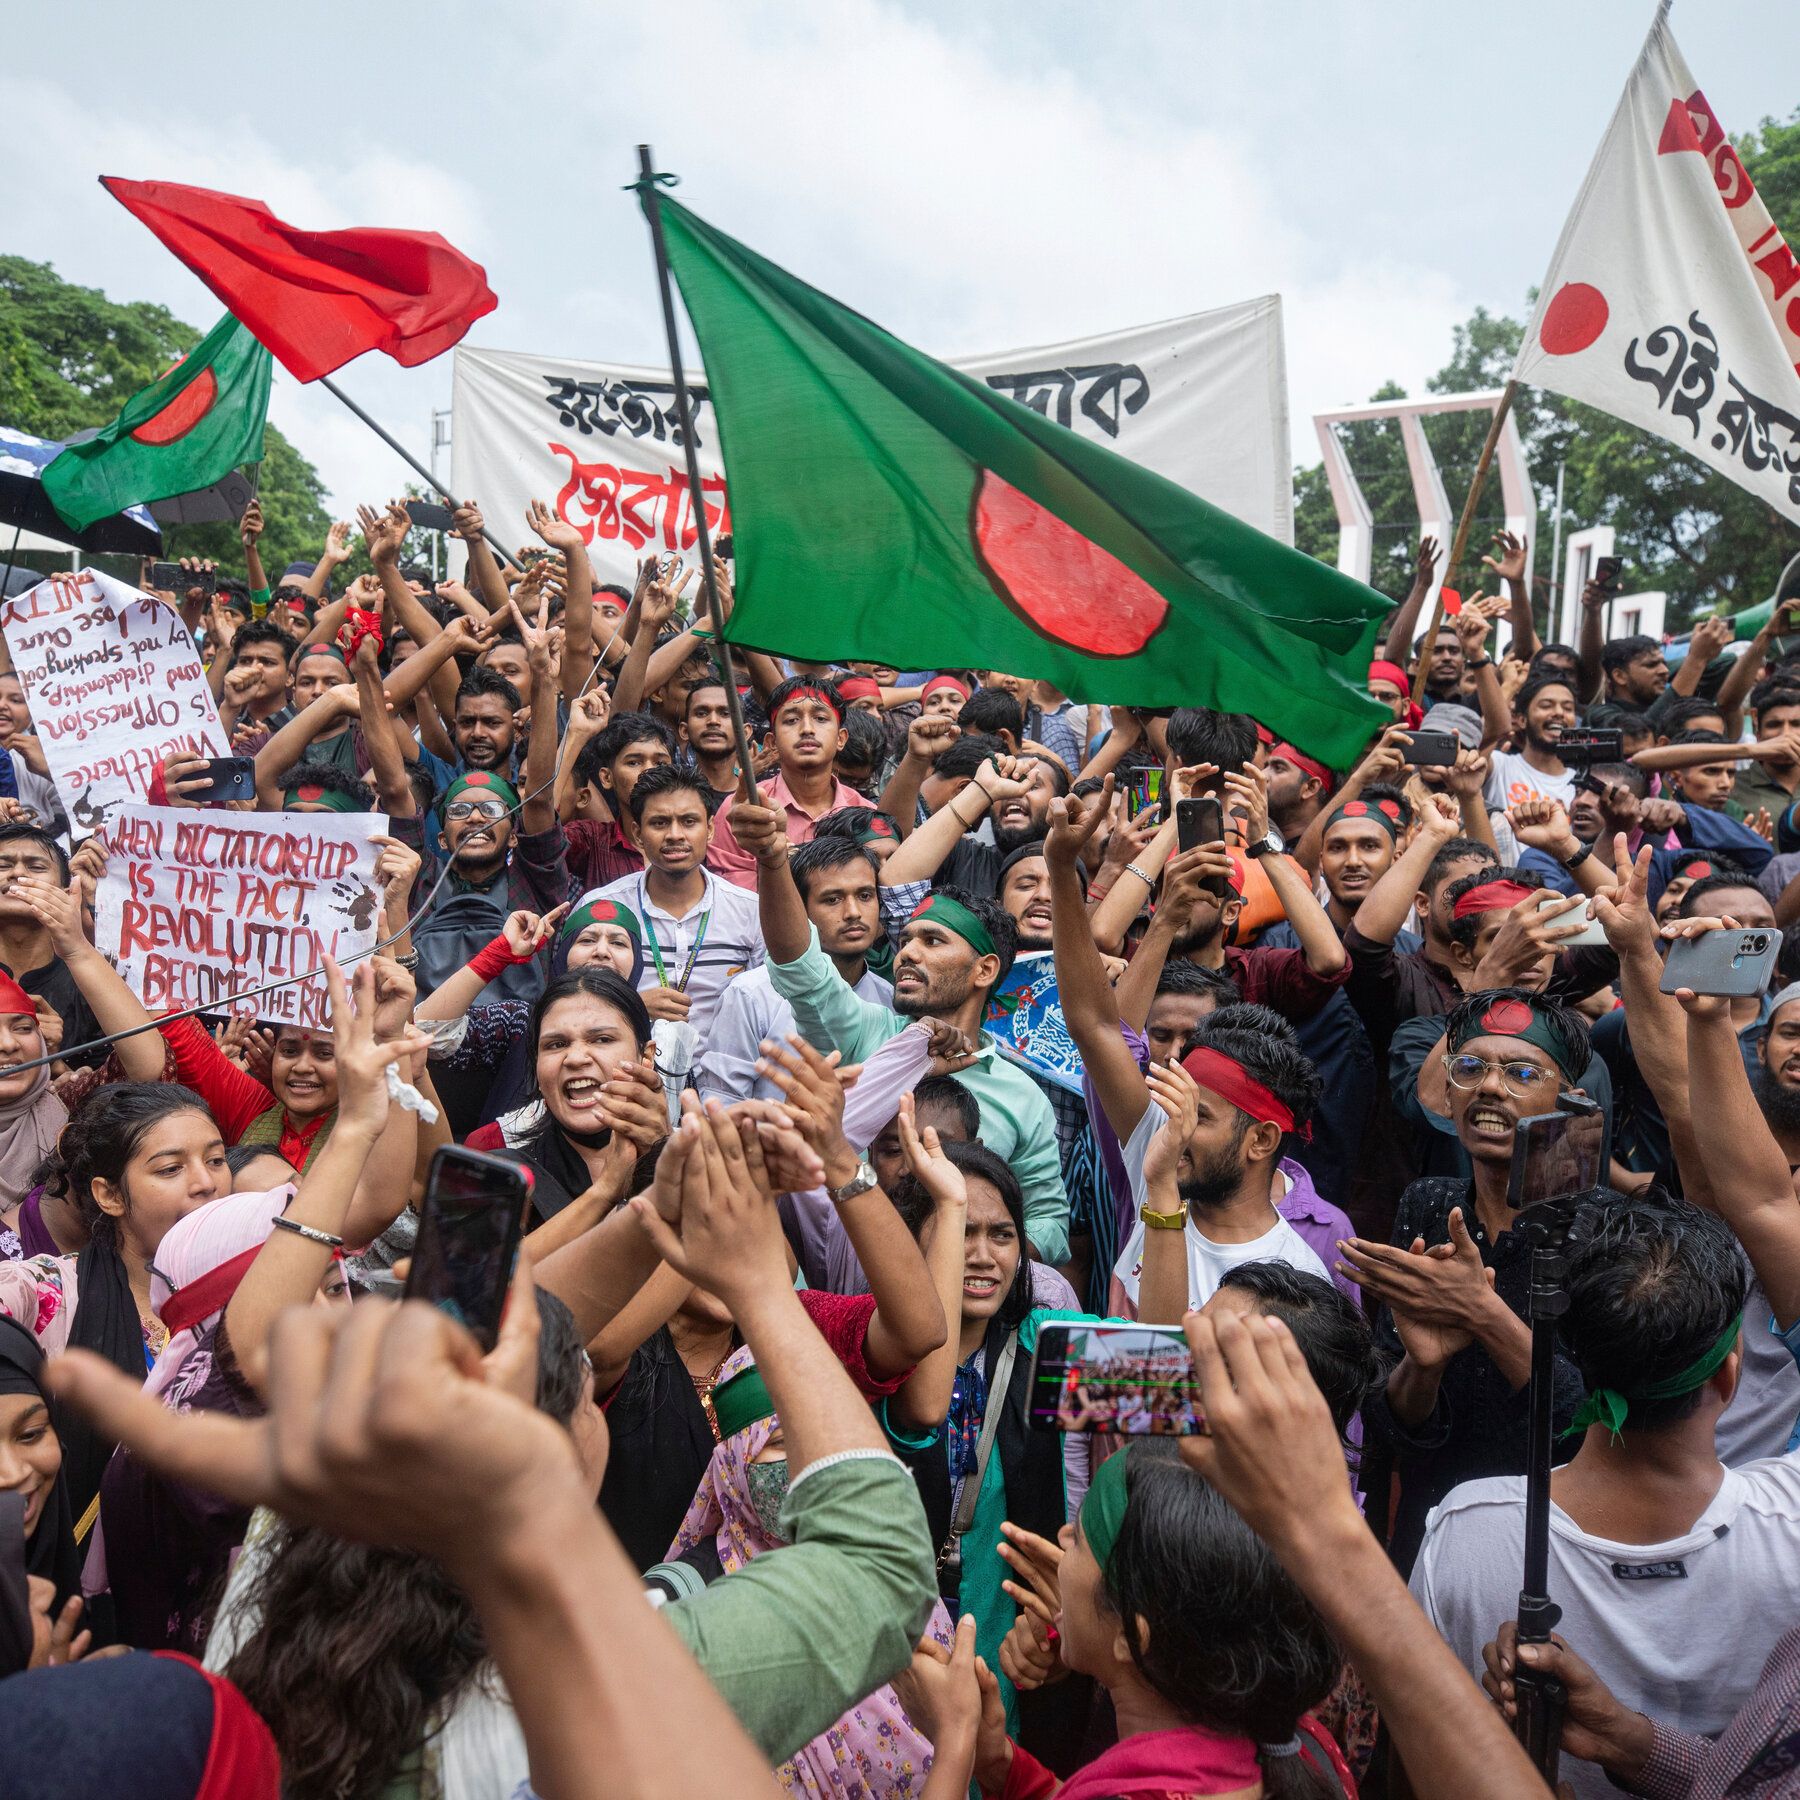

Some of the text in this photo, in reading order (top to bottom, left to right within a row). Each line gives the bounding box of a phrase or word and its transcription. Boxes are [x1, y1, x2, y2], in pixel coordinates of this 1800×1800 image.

[1624, 309, 1720, 440] এই
[131, 637, 163, 663] not
[168, 620, 191, 650] by
[166, 661, 201, 691] and
[191, 689, 217, 722] is
[102, 815, 359, 880] WHEN DICTATORSHIP
[128, 861, 155, 902] IS
[163, 865, 227, 913] THE
[119, 900, 339, 988] REVOLUTION
[143, 953, 260, 1020] BECOMES
[261, 986, 296, 1019] THE
